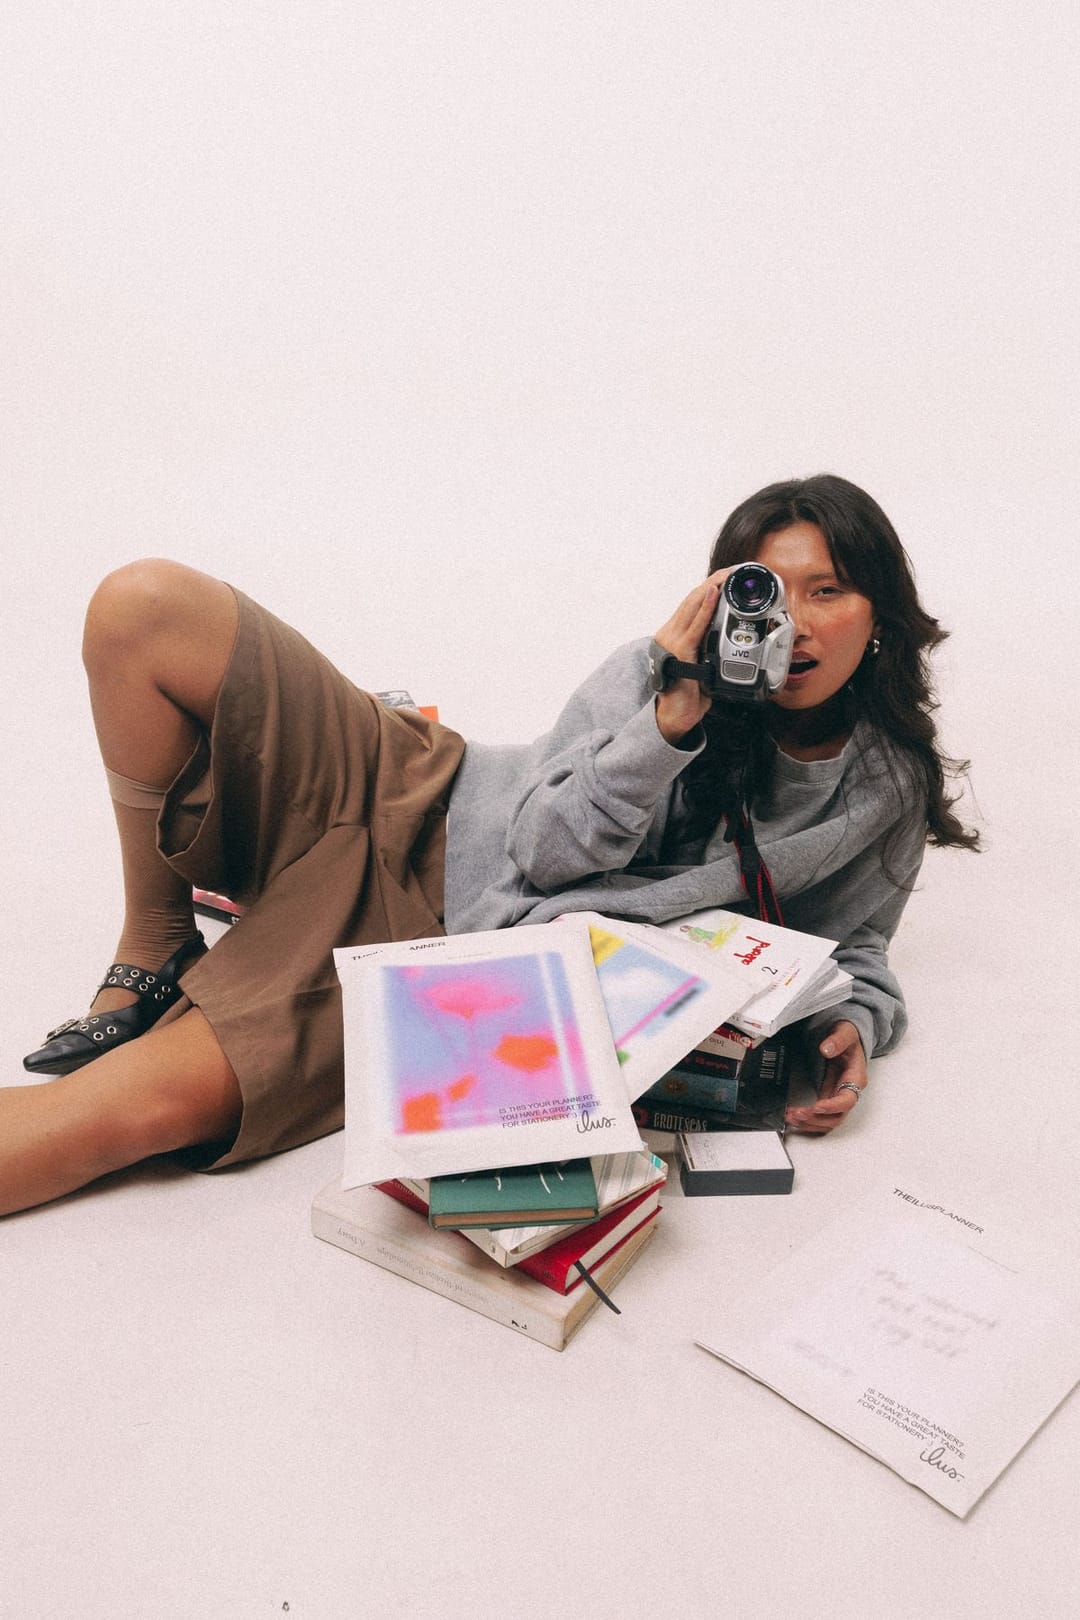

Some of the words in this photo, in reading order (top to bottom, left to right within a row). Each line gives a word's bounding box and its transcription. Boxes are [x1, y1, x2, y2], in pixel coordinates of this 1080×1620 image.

[731, 650, 750, 658] JVC
[761, 966, 778, 976] 2
[509, 1105, 526, 1113] THIS
[528, 1101, 551, 1109] YOUR
[520, 1111, 540, 1119] HAVE
[549, 1105, 576, 1114] GREAT
[577, 1100, 601, 1110] TASTE
[521, 1113, 570, 1126] STATIONERY
[893, 1187, 984, 1234] THEILUSPLANNER
[857, 1398, 876, 1412] FOR
[876, 1409, 928, 1441] STATIONERY
[863, 1393, 881, 1406] YOU
[881, 1403, 904, 1420] HAVE
[910, 1420, 939, 1440] GREAT
[940, 1437, 966, 1460] TASTE
[866, 1387, 876, 1395] IS
[877, 1392, 896, 1406] THIS
[896, 1403, 920, 1420] YOUR
[921, 1418, 965, 1448] PLANNER?
